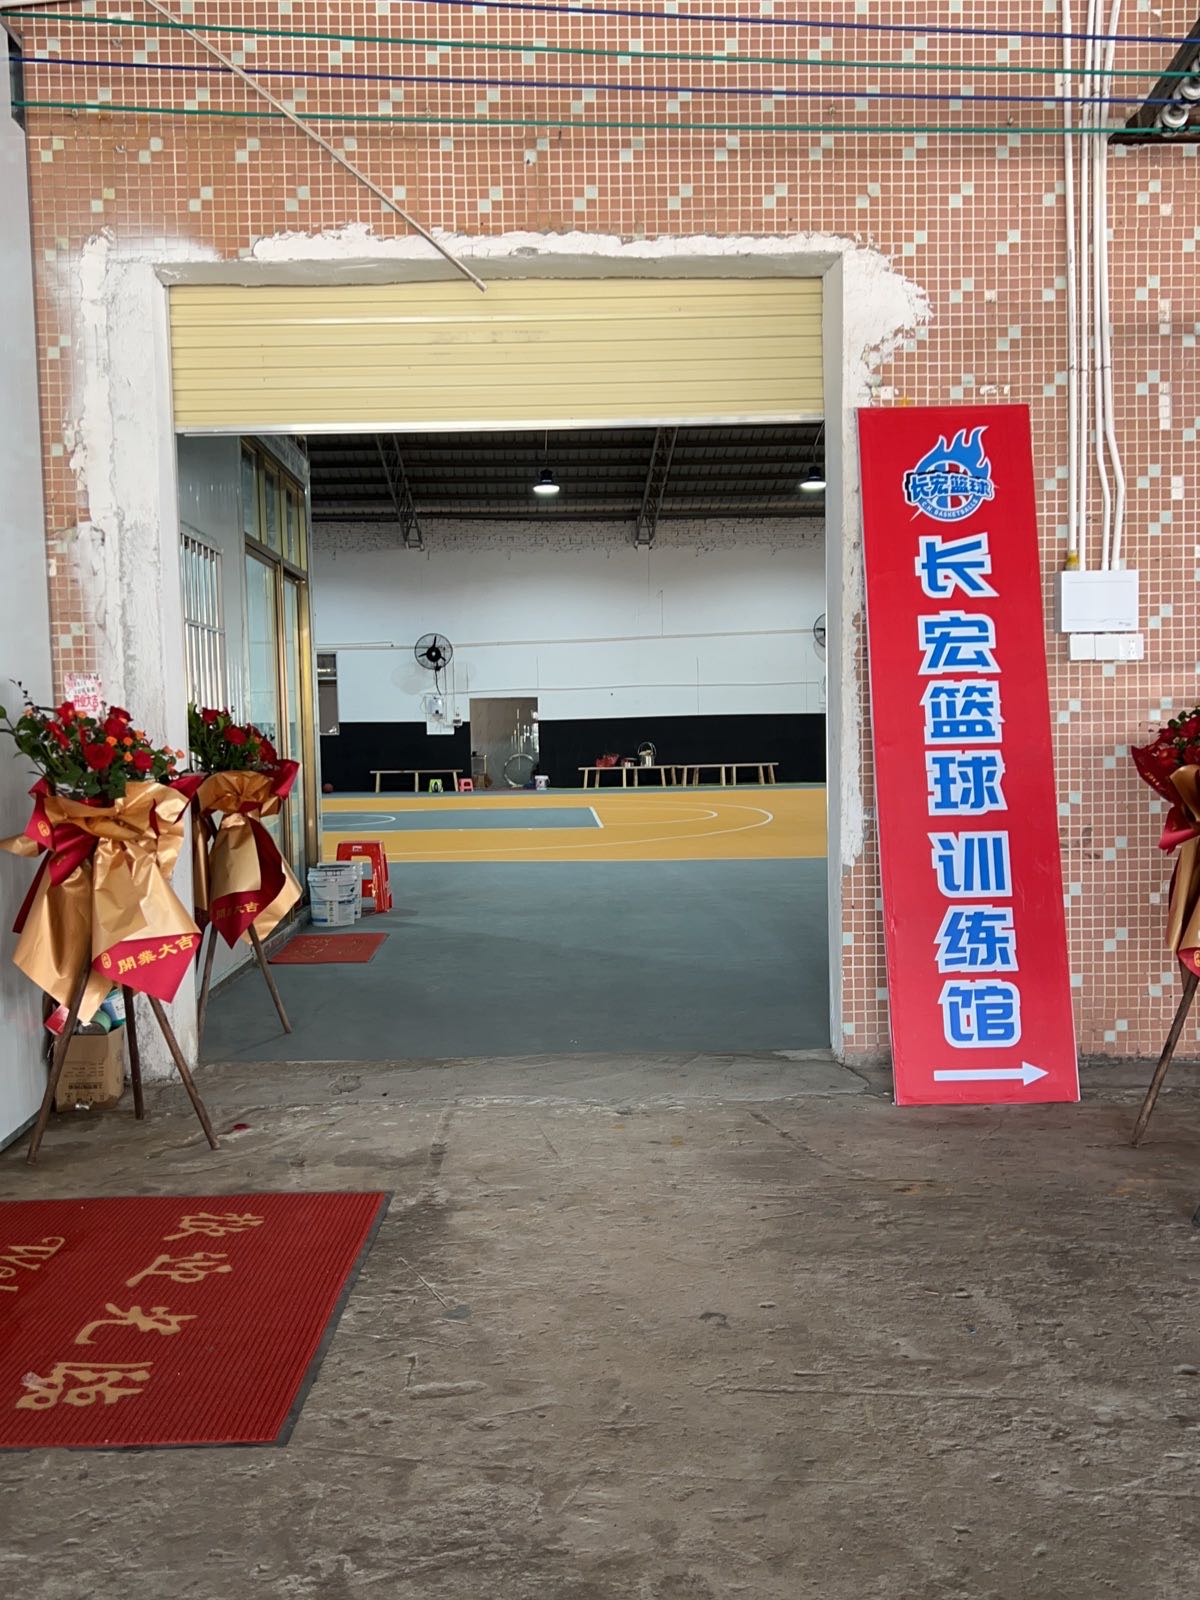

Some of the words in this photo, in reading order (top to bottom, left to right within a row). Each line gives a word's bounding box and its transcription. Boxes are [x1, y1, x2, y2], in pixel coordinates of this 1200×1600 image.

[908, 472, 992, 502] 长宏篮球
[914, 532, 1021, 1049] 长宏篮球训练馆
[117, 934, 195, 975] 開業大吉
